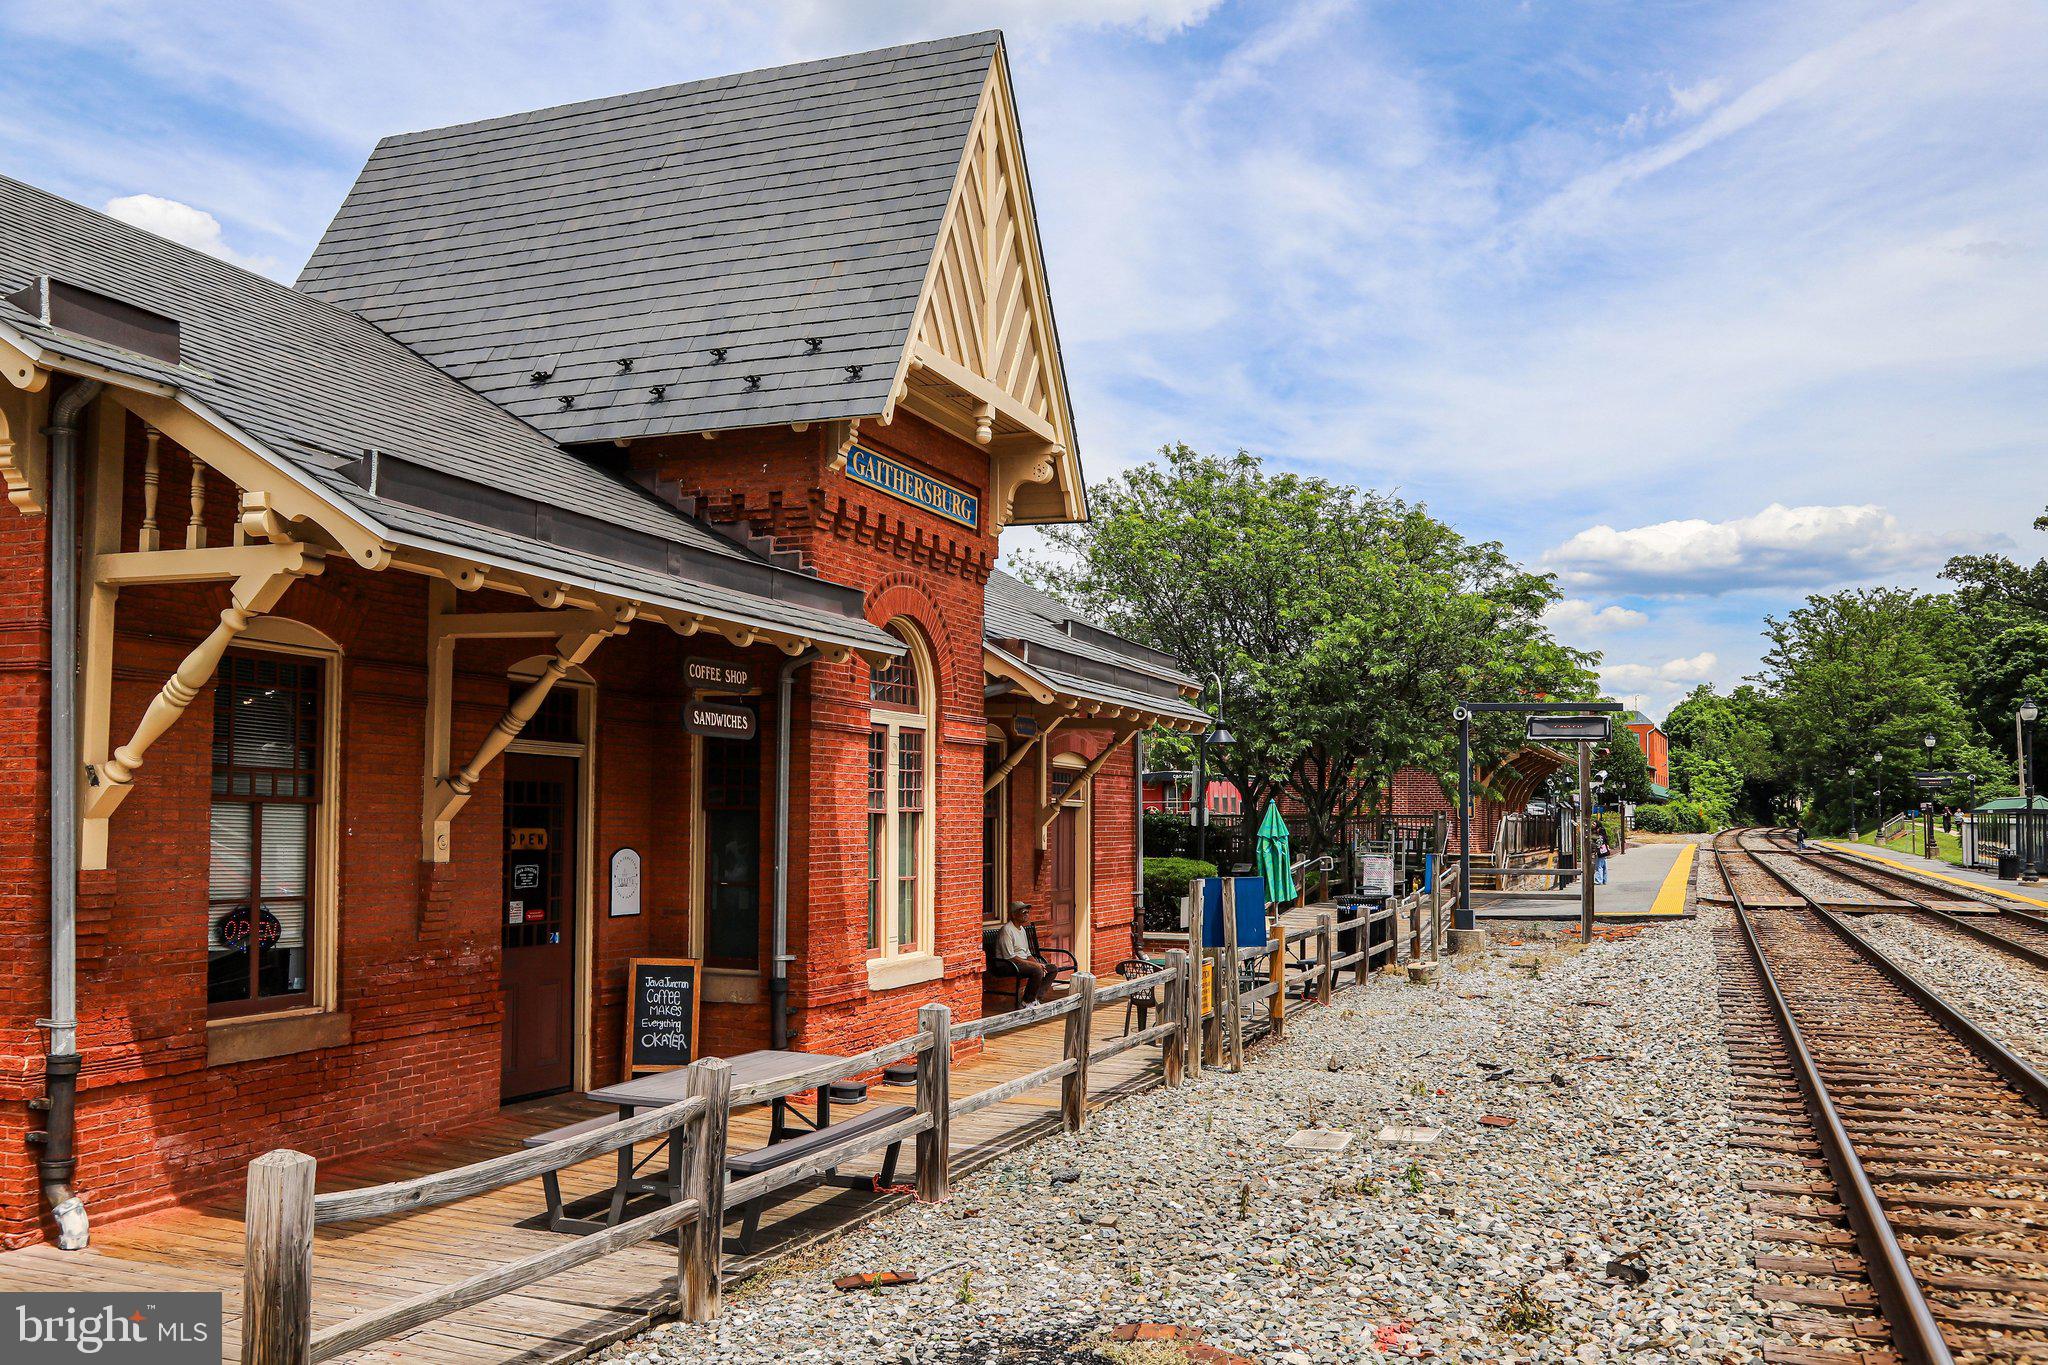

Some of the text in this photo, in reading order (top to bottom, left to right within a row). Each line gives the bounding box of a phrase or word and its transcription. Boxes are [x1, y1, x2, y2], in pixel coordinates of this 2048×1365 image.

[852, 451, 972, 520] GAITHERSBURG
[689, 663, 748, 684] COFFEE SHOP
[693, 710, 748, 729] SANDWICHES
[224, 920, 278, 941] OPEN
[645, 976, 664, 988] Java
[646, 988, 681, 1005] Coffee
[641, 1018, 682, 1033] Everything
[641, 1030, 688, 1051] OKAYER
